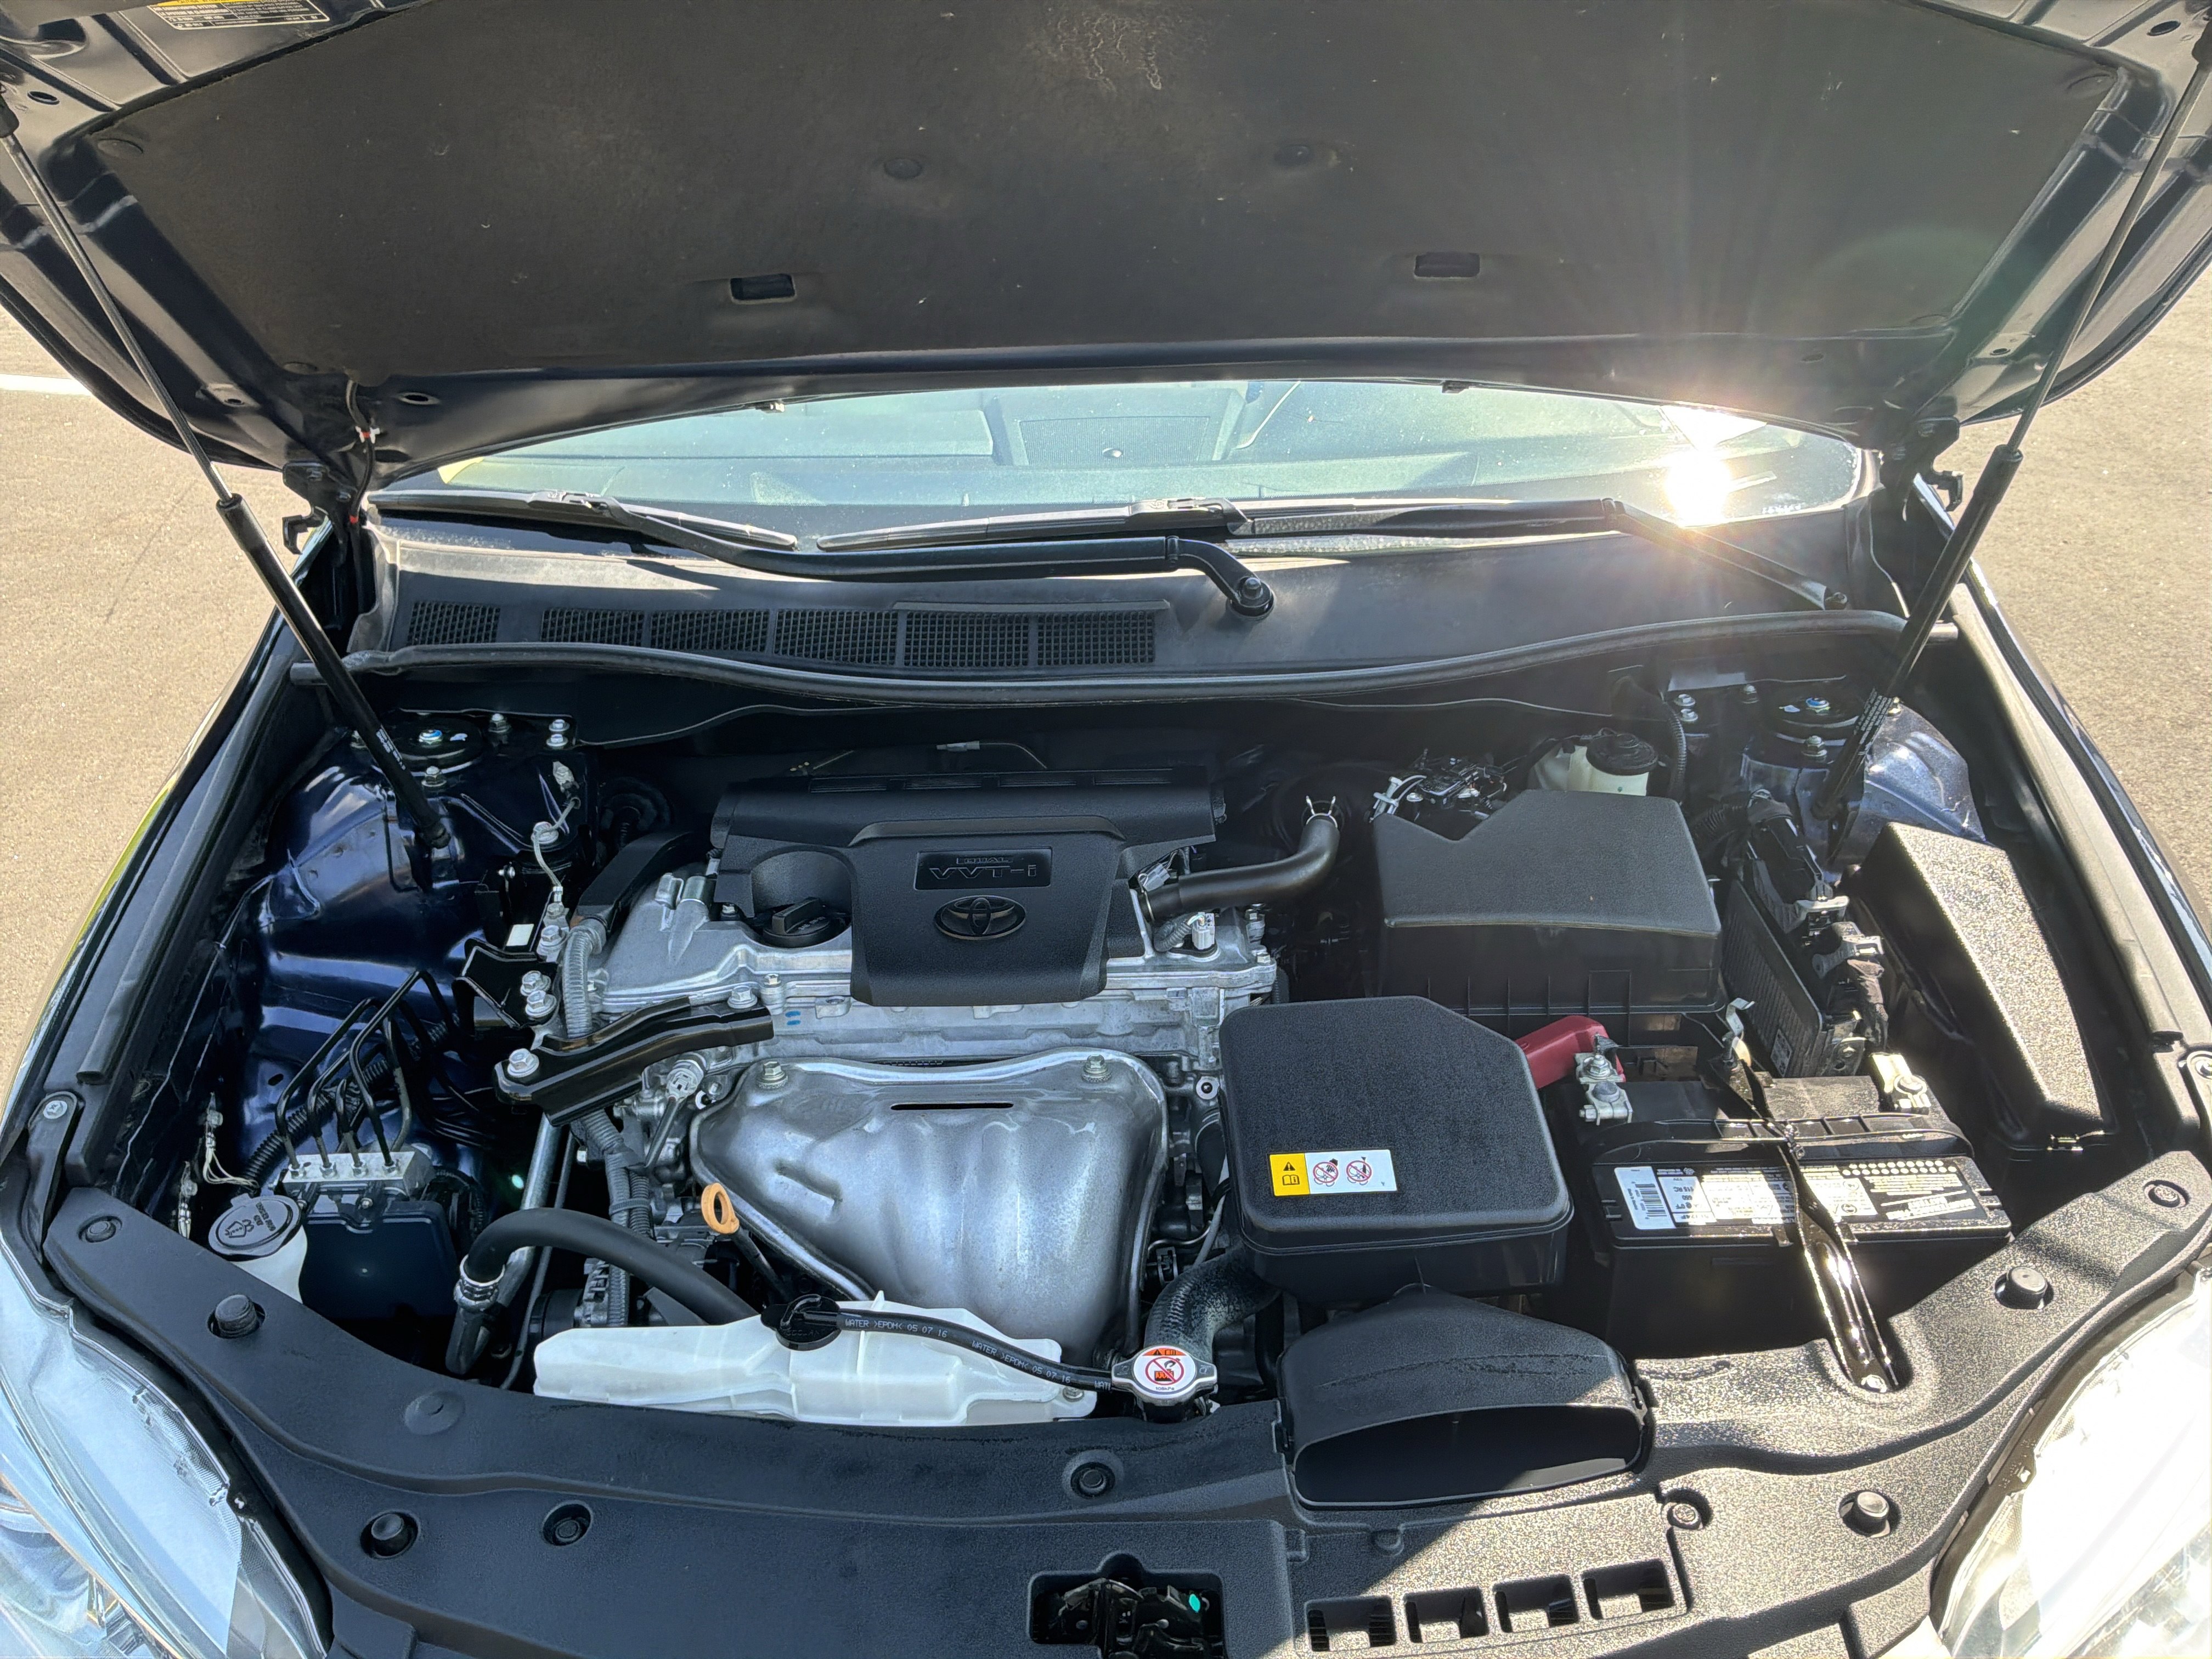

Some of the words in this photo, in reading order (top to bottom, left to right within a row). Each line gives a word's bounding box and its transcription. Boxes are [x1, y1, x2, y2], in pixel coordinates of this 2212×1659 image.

[845, 1319, 870, 1328] WATER
[907, 1324, 918, 1332] 05
[922, 1326, 933, 1334] 07
[938, 1329, 948, 1338] 16
[972, 1340, 997, 1356] WATER
[1032, 1365, 1043, 1374] 05
[1046, 1370, 1057, 1379] 07
[1062, 1375, 1071, 1384] 16
